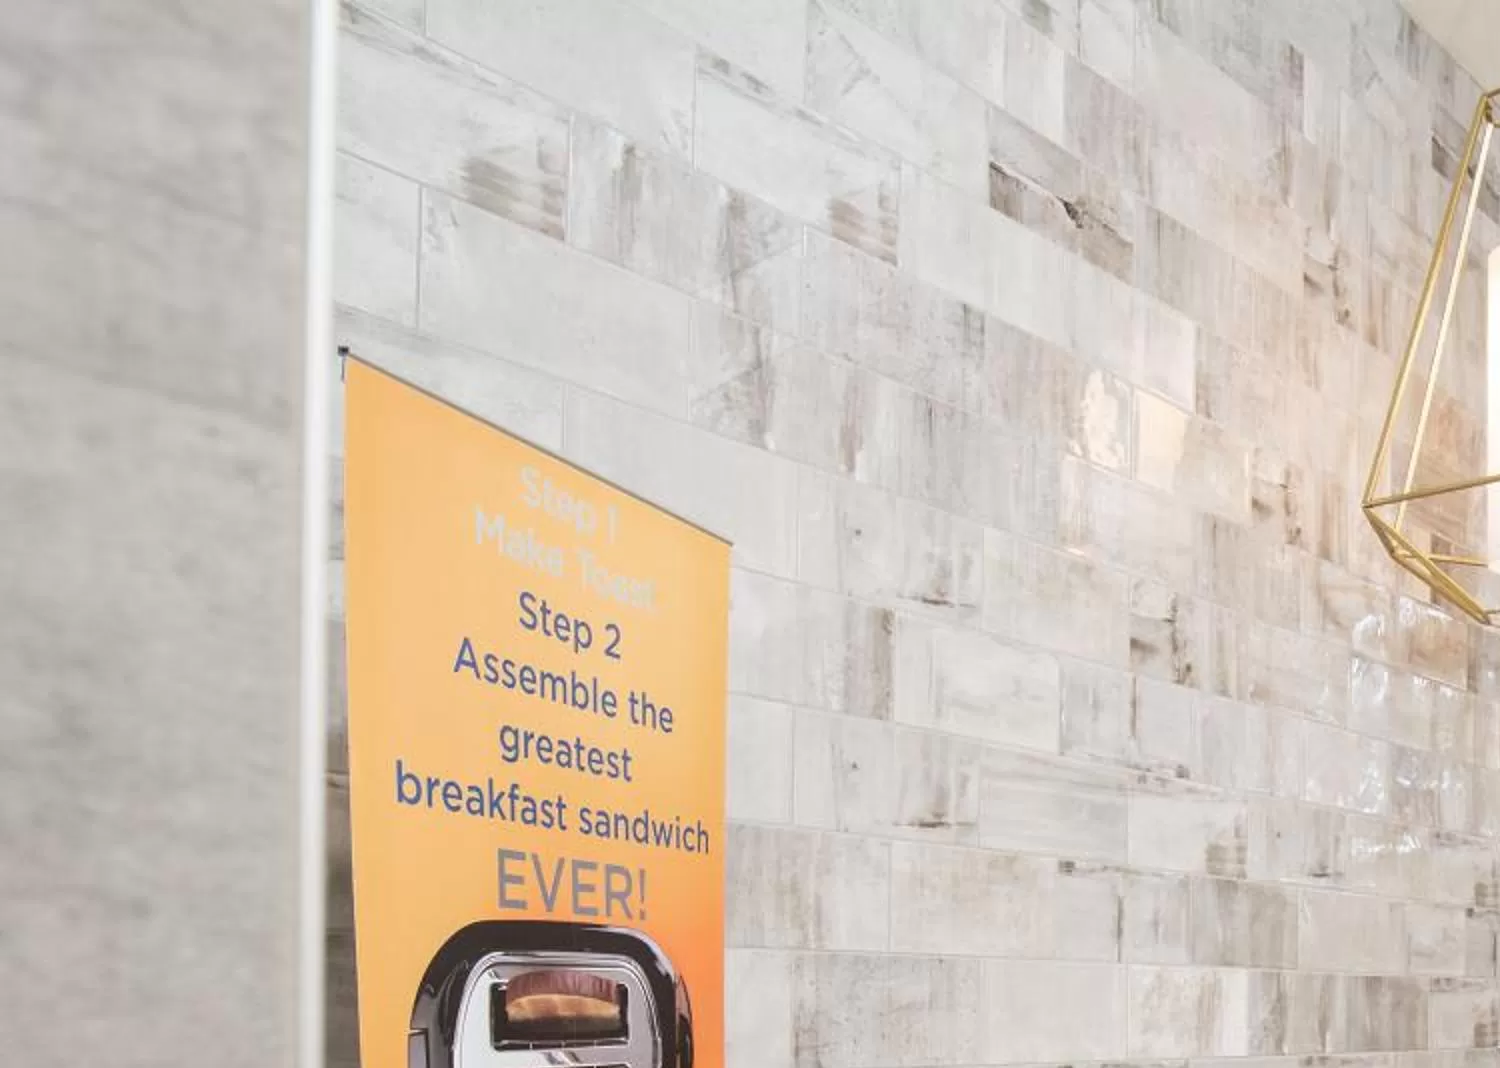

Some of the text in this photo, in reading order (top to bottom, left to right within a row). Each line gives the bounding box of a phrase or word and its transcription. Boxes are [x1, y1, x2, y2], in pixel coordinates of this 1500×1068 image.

[518, 591, 622, 659] Step 2
[453, 637, 674, 733] Assemble the
[499, 724, 633, 782] greatest
[395, 759, 710, 855] breakfast sandwich
[497, 847, 646, 920] EVER!
